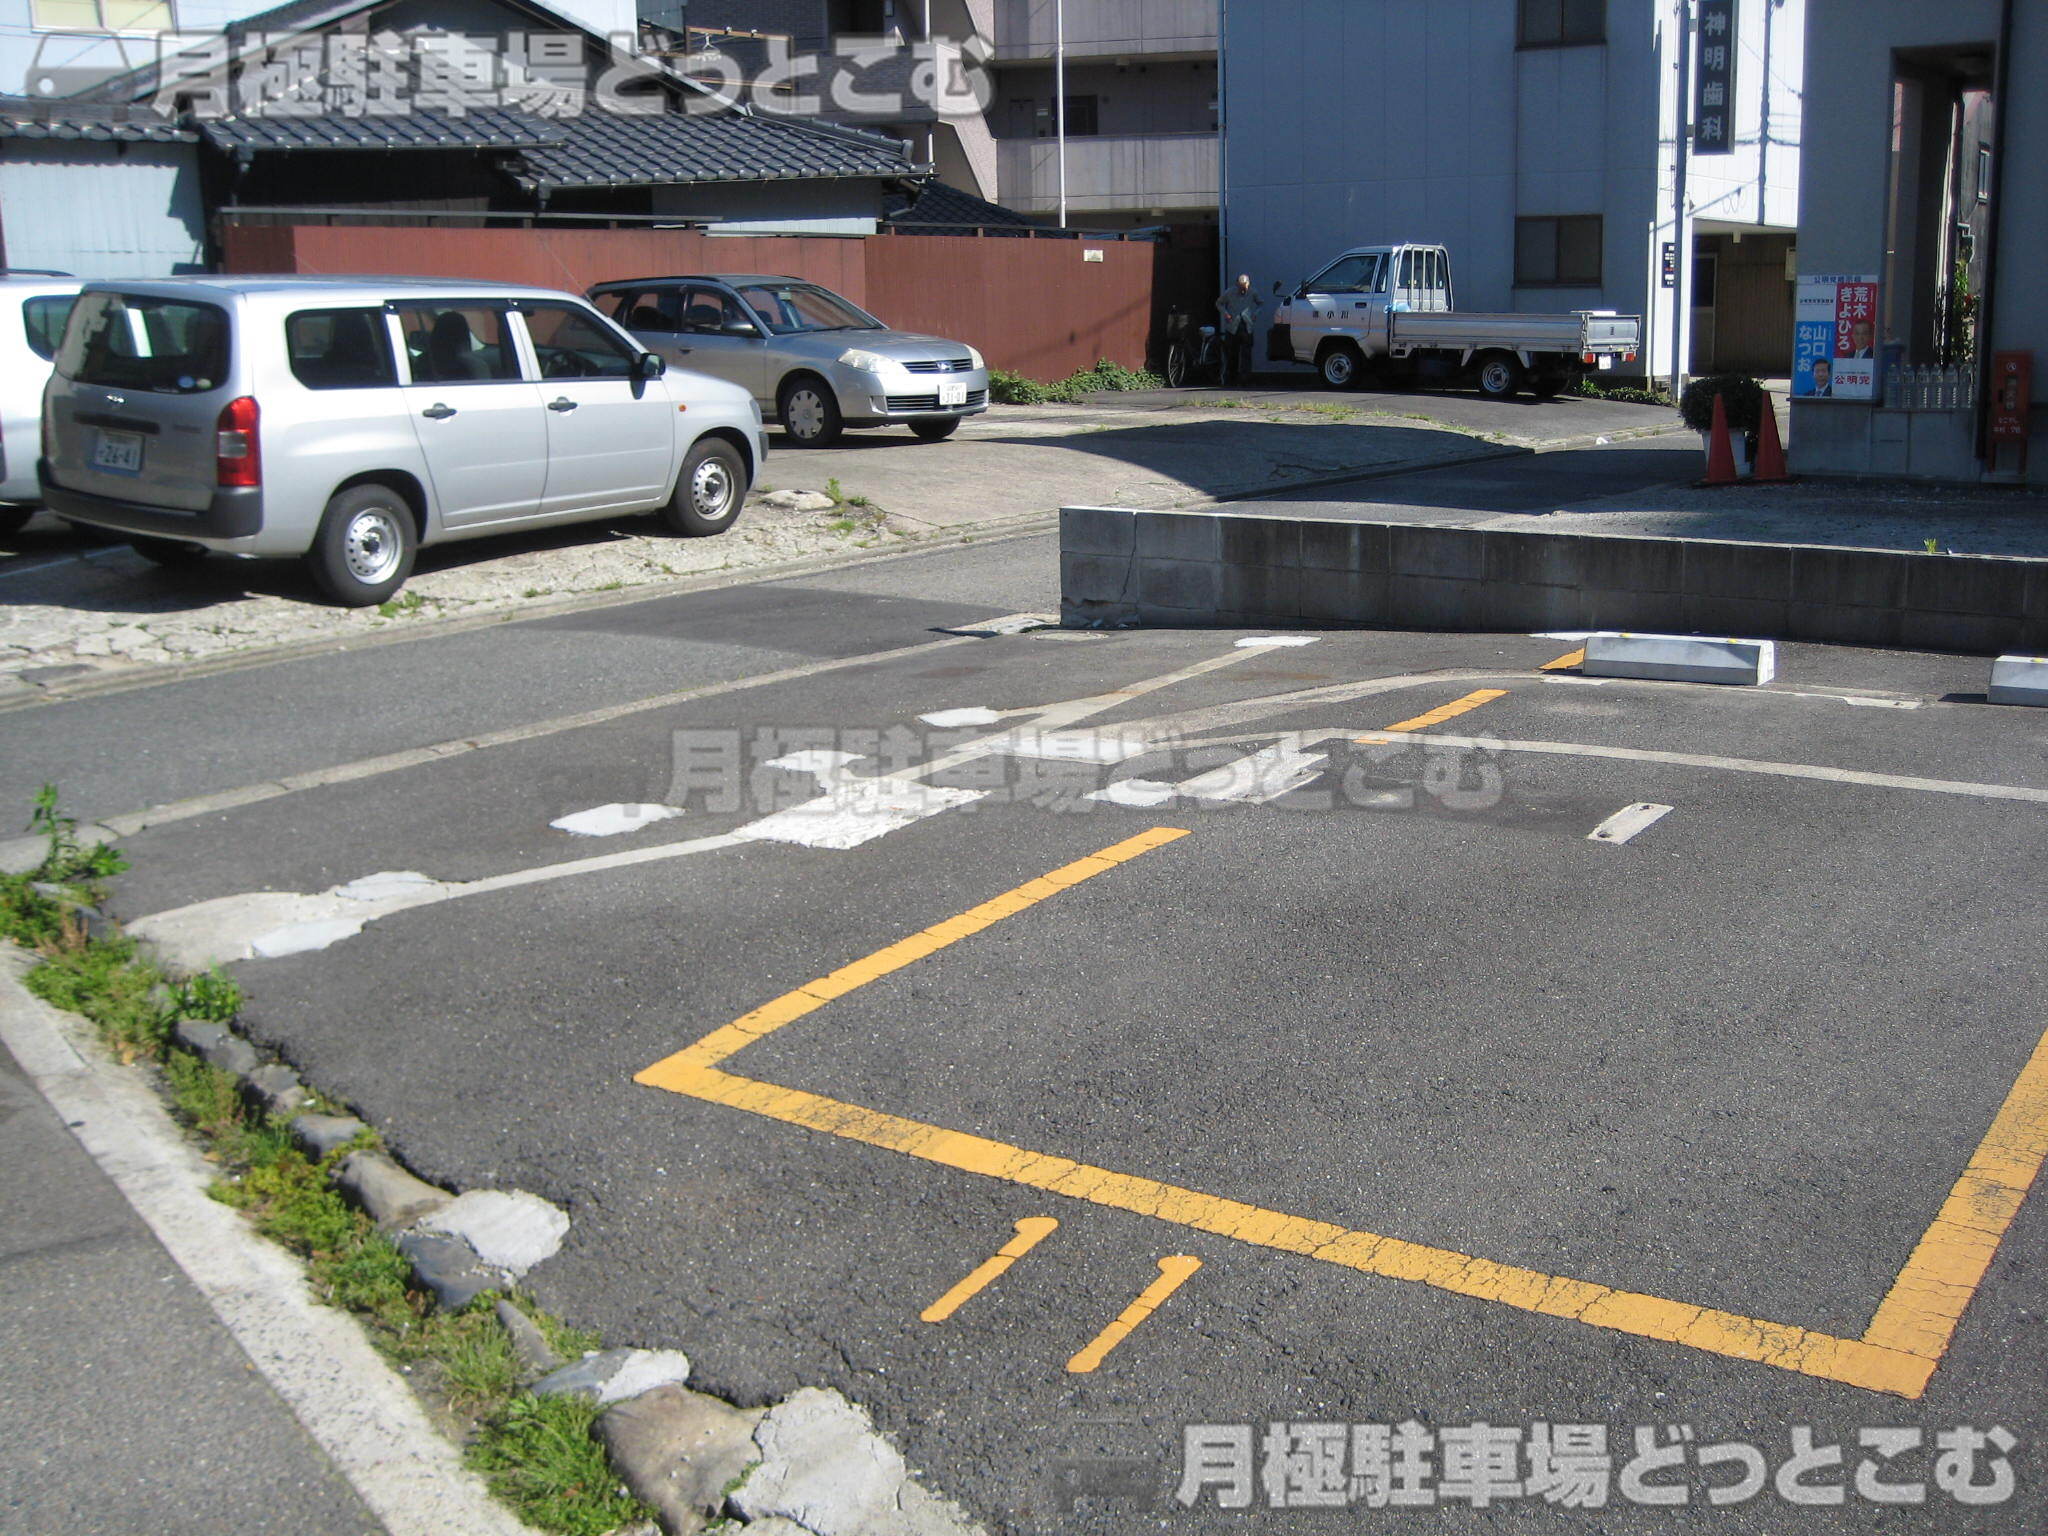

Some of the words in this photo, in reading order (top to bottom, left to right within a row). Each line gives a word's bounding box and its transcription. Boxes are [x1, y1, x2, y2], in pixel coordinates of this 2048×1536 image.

[1701, 11, 1727, 141] 神明歯科
[1838, 287, 1853, 350] きよひろ
[1853, 286, 1869, 318] 荒木
[1798, 325, 1813, 372] なつお
[1813, 325, 1827, 356] 山口
[1835, 375, 1870, 385] 公明党
